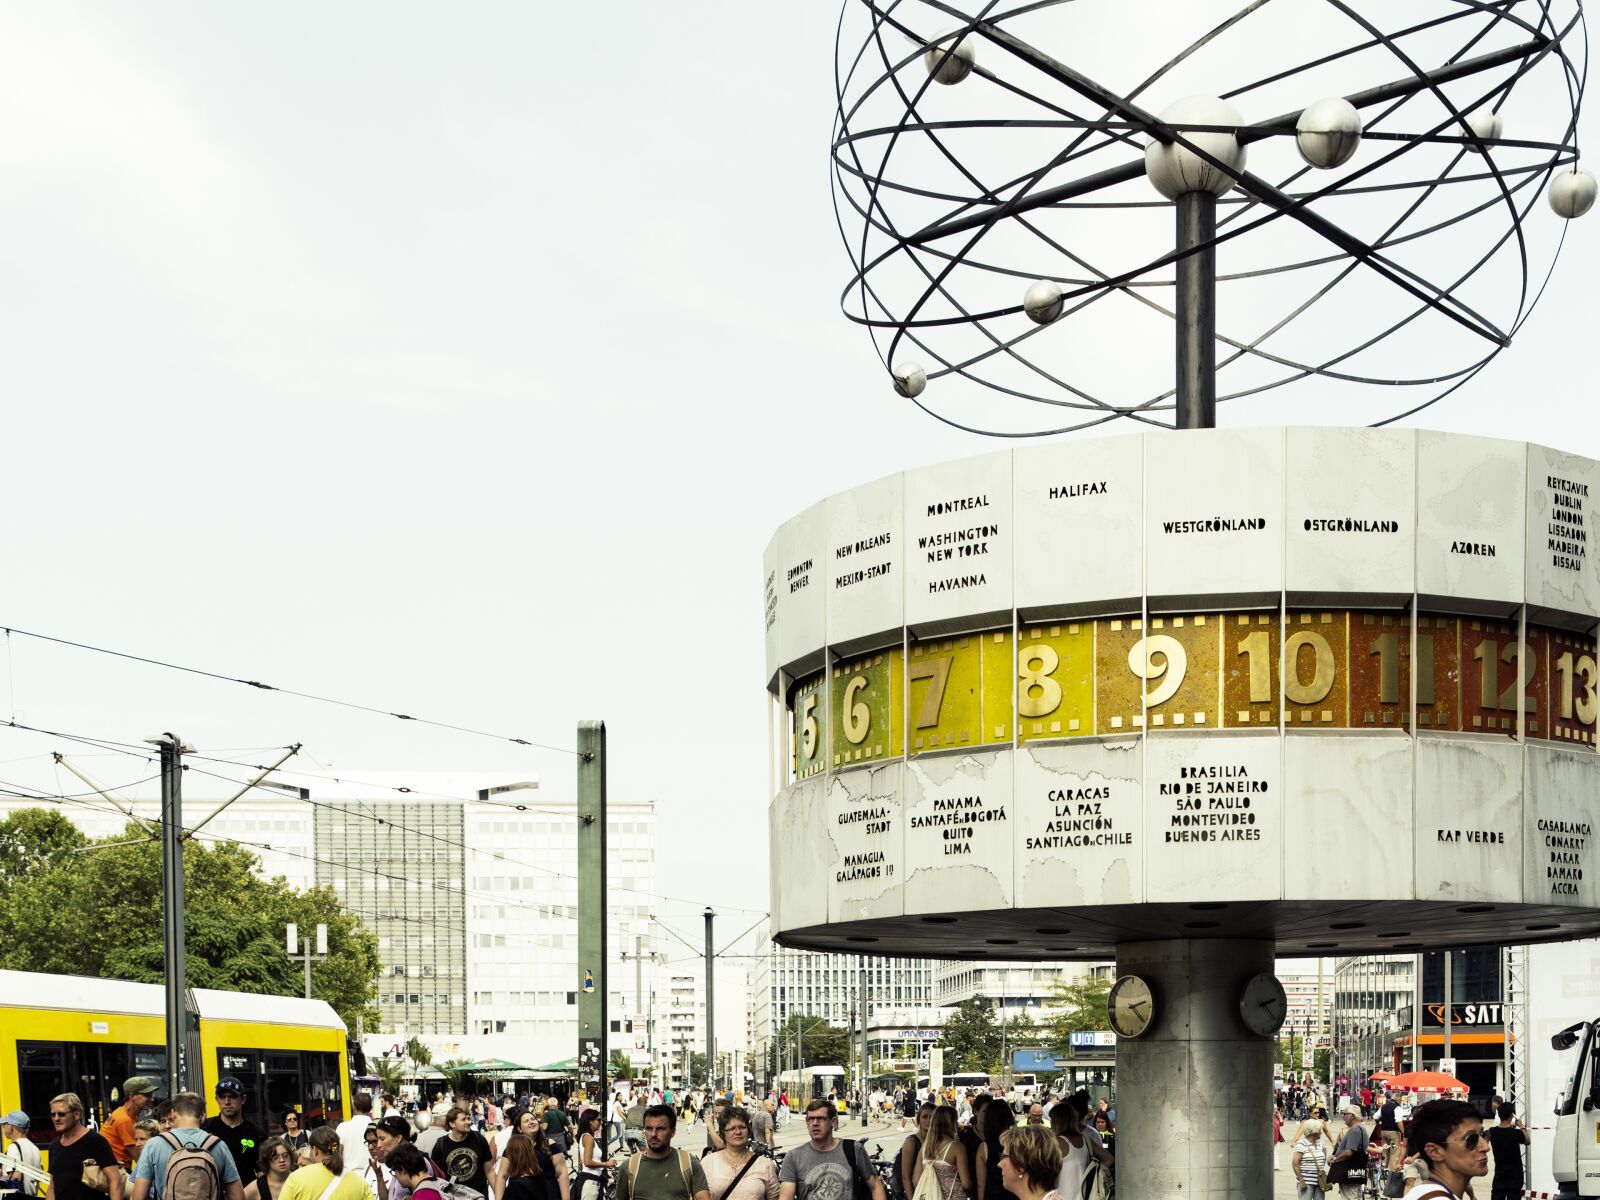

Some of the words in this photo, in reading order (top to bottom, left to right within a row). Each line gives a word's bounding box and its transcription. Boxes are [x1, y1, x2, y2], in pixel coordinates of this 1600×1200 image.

[1049, 481, 1108, 500] HALIFAX
[1547, 475, 1589, 497] REYKJAVIK
[927, 495, 990, 517] MONTREAL
[1554, 493, 1582, 510] DUBLIN
[1163, 517, 1266, 534] WESTGRÖNLAND
[1303, 517, 1399, 533] OSTGRÖNLAND
[1552, 508, 1583, 526] LONDON
[918, 524, 998, 549] WASHINGTON
[1548, 523, 1587, 542] LISSABON
[836, 545, 853, 559] NEW
[855, 532, 891, 553] ORLEANS
[927, 549, 953, 563] NEW
[957, 542, 989, 558] YORK
[1450, 541, 1497, 557] AZOREN
[1548, 538, 1586, 557] MADEIRA
[787, 559, 813, 581] EDMONTON
[1553, 555, 1581, 571] BISSAU
[790, 575, 810, 594] DENVER
[836, 562, 892, 589] MEXIKO-STADT
[929, 573, 987, 594] HAVANNA
[1128, 634, 1187, 708] 9
[1238, 631, 1335, 704] 10
[1371, 633, 1434, 704] 11
[1475, 639, 1537, 712] 12
[1012, 645, 1062, 718] 8
[1556, 651, 1597, 725] 13
[910, 656, 954, 730] 7
[843, 676, 871, 744] 6
[803, 694, 818, 760] 5
[1180, 765, 1248, 779] BRASILIA
[1048, 787, 1110, 802] CARACAS
[1160, 782, 1181, 796] RIO
[1186, 782, 1202, 795] DE
[1207, 780, 1269, 794] JANEIRO
[933, 796, 983, 811] PANAMA
[1055, 805, 1072, 817] LA
[1078, 802, 1102, 816] PAZ
[1209, 796, 1251, 810] PAULO
[838, 807, 891, 825] GUATEMALA-
[1045, 815, 1113, 833] ASUNCIÓN
[1171, 812, 1256, 827] MONTEVIDEO
[866, 820, 891, 835] STADT
[942, 827, 974, 841] QUITO
[1165, 830, 1217, 843] BUENOS
[1221, 828, 1261, 841] AIRES
[1437, 829, 1461, 842] KAP
[1465, 830, 1504, 844] VERDE
[1537, 818, 1592, 837] CASABLANCA
[944, 842, 972, 856] LIMA
[1545, 835, 1585, 850] CONAKRY
[844, 851, 885, 867] MANAGUA
[1550, 851, 1580, 865] DAKAR
[836, 866, 881, 883] GALÁPAGOS
[1547, 866, 1583, 881] BAMAKO
[1550, 882, 1579, 896] ACCRA
